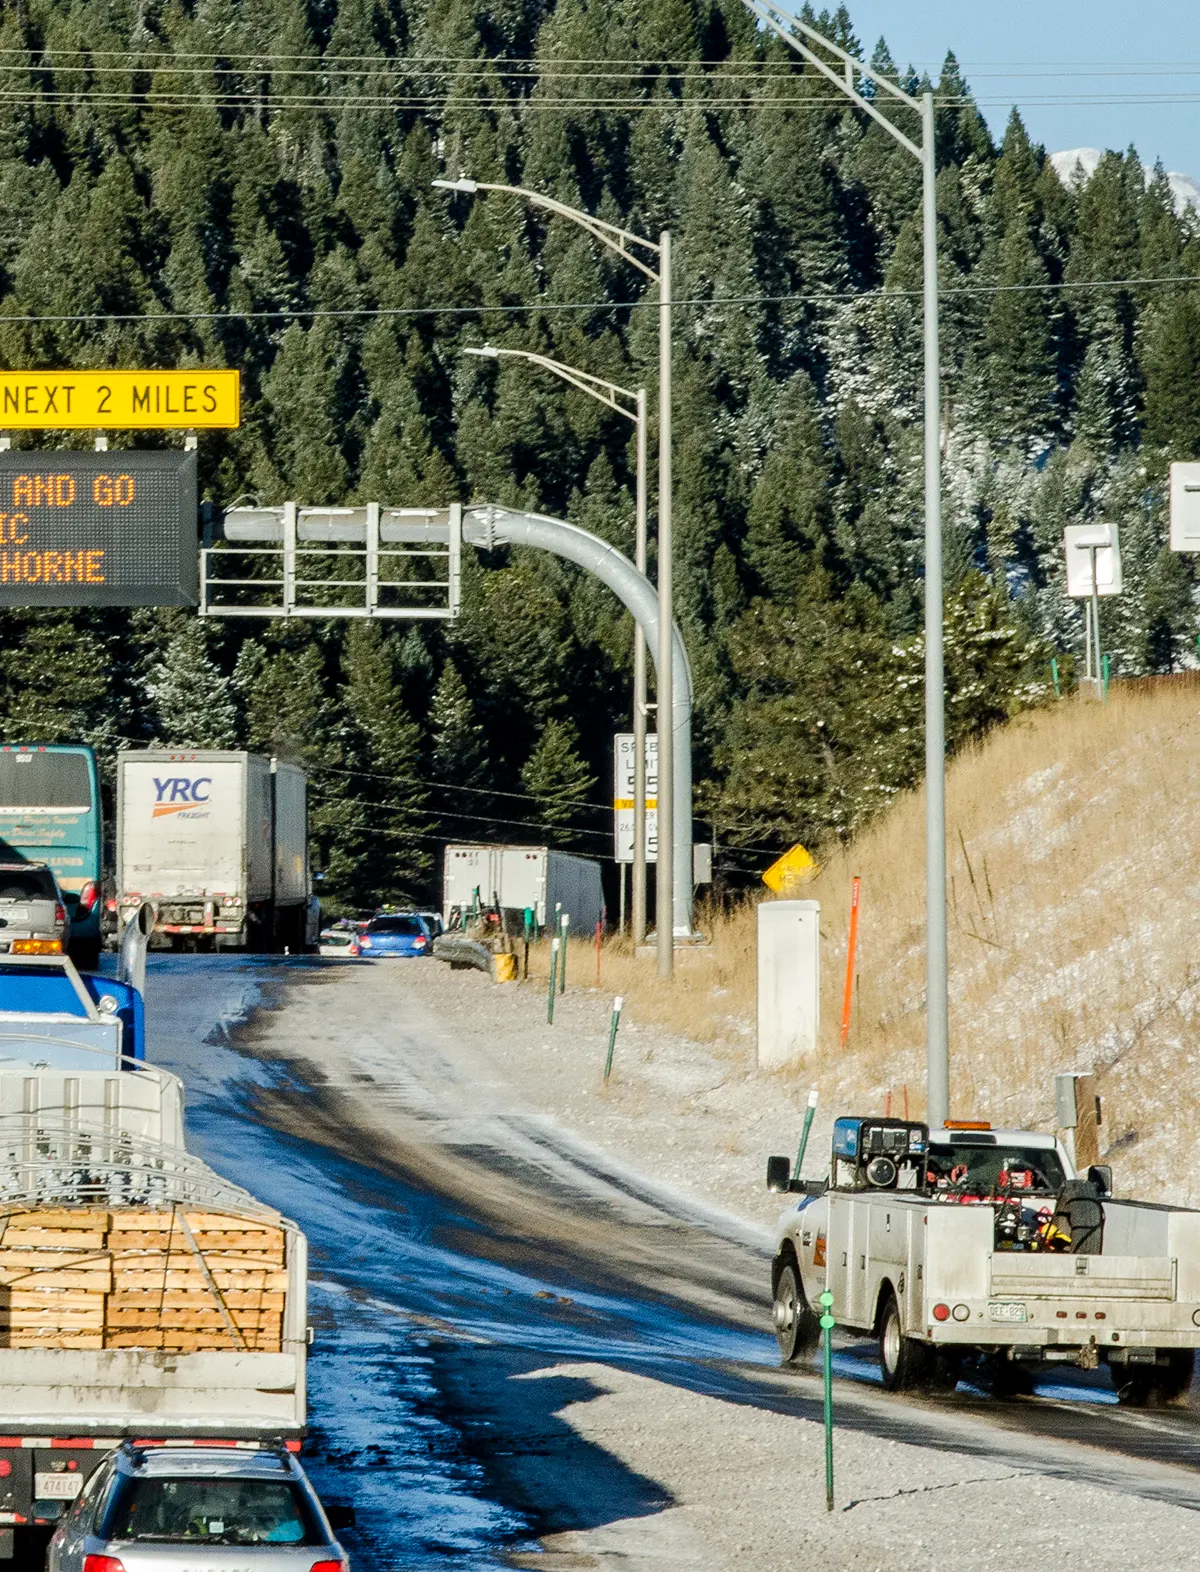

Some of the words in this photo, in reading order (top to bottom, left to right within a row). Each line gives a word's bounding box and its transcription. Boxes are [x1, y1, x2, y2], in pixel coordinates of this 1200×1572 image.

[3, 386, 76, 414] NEXT
[96, 385, 112, 413] 2
[132, 385, 217, 413] MILES
[12, 474, 77, 507] AND
[92, 474, 135, 507] GO
[152, 777, 213, 802] YRC
